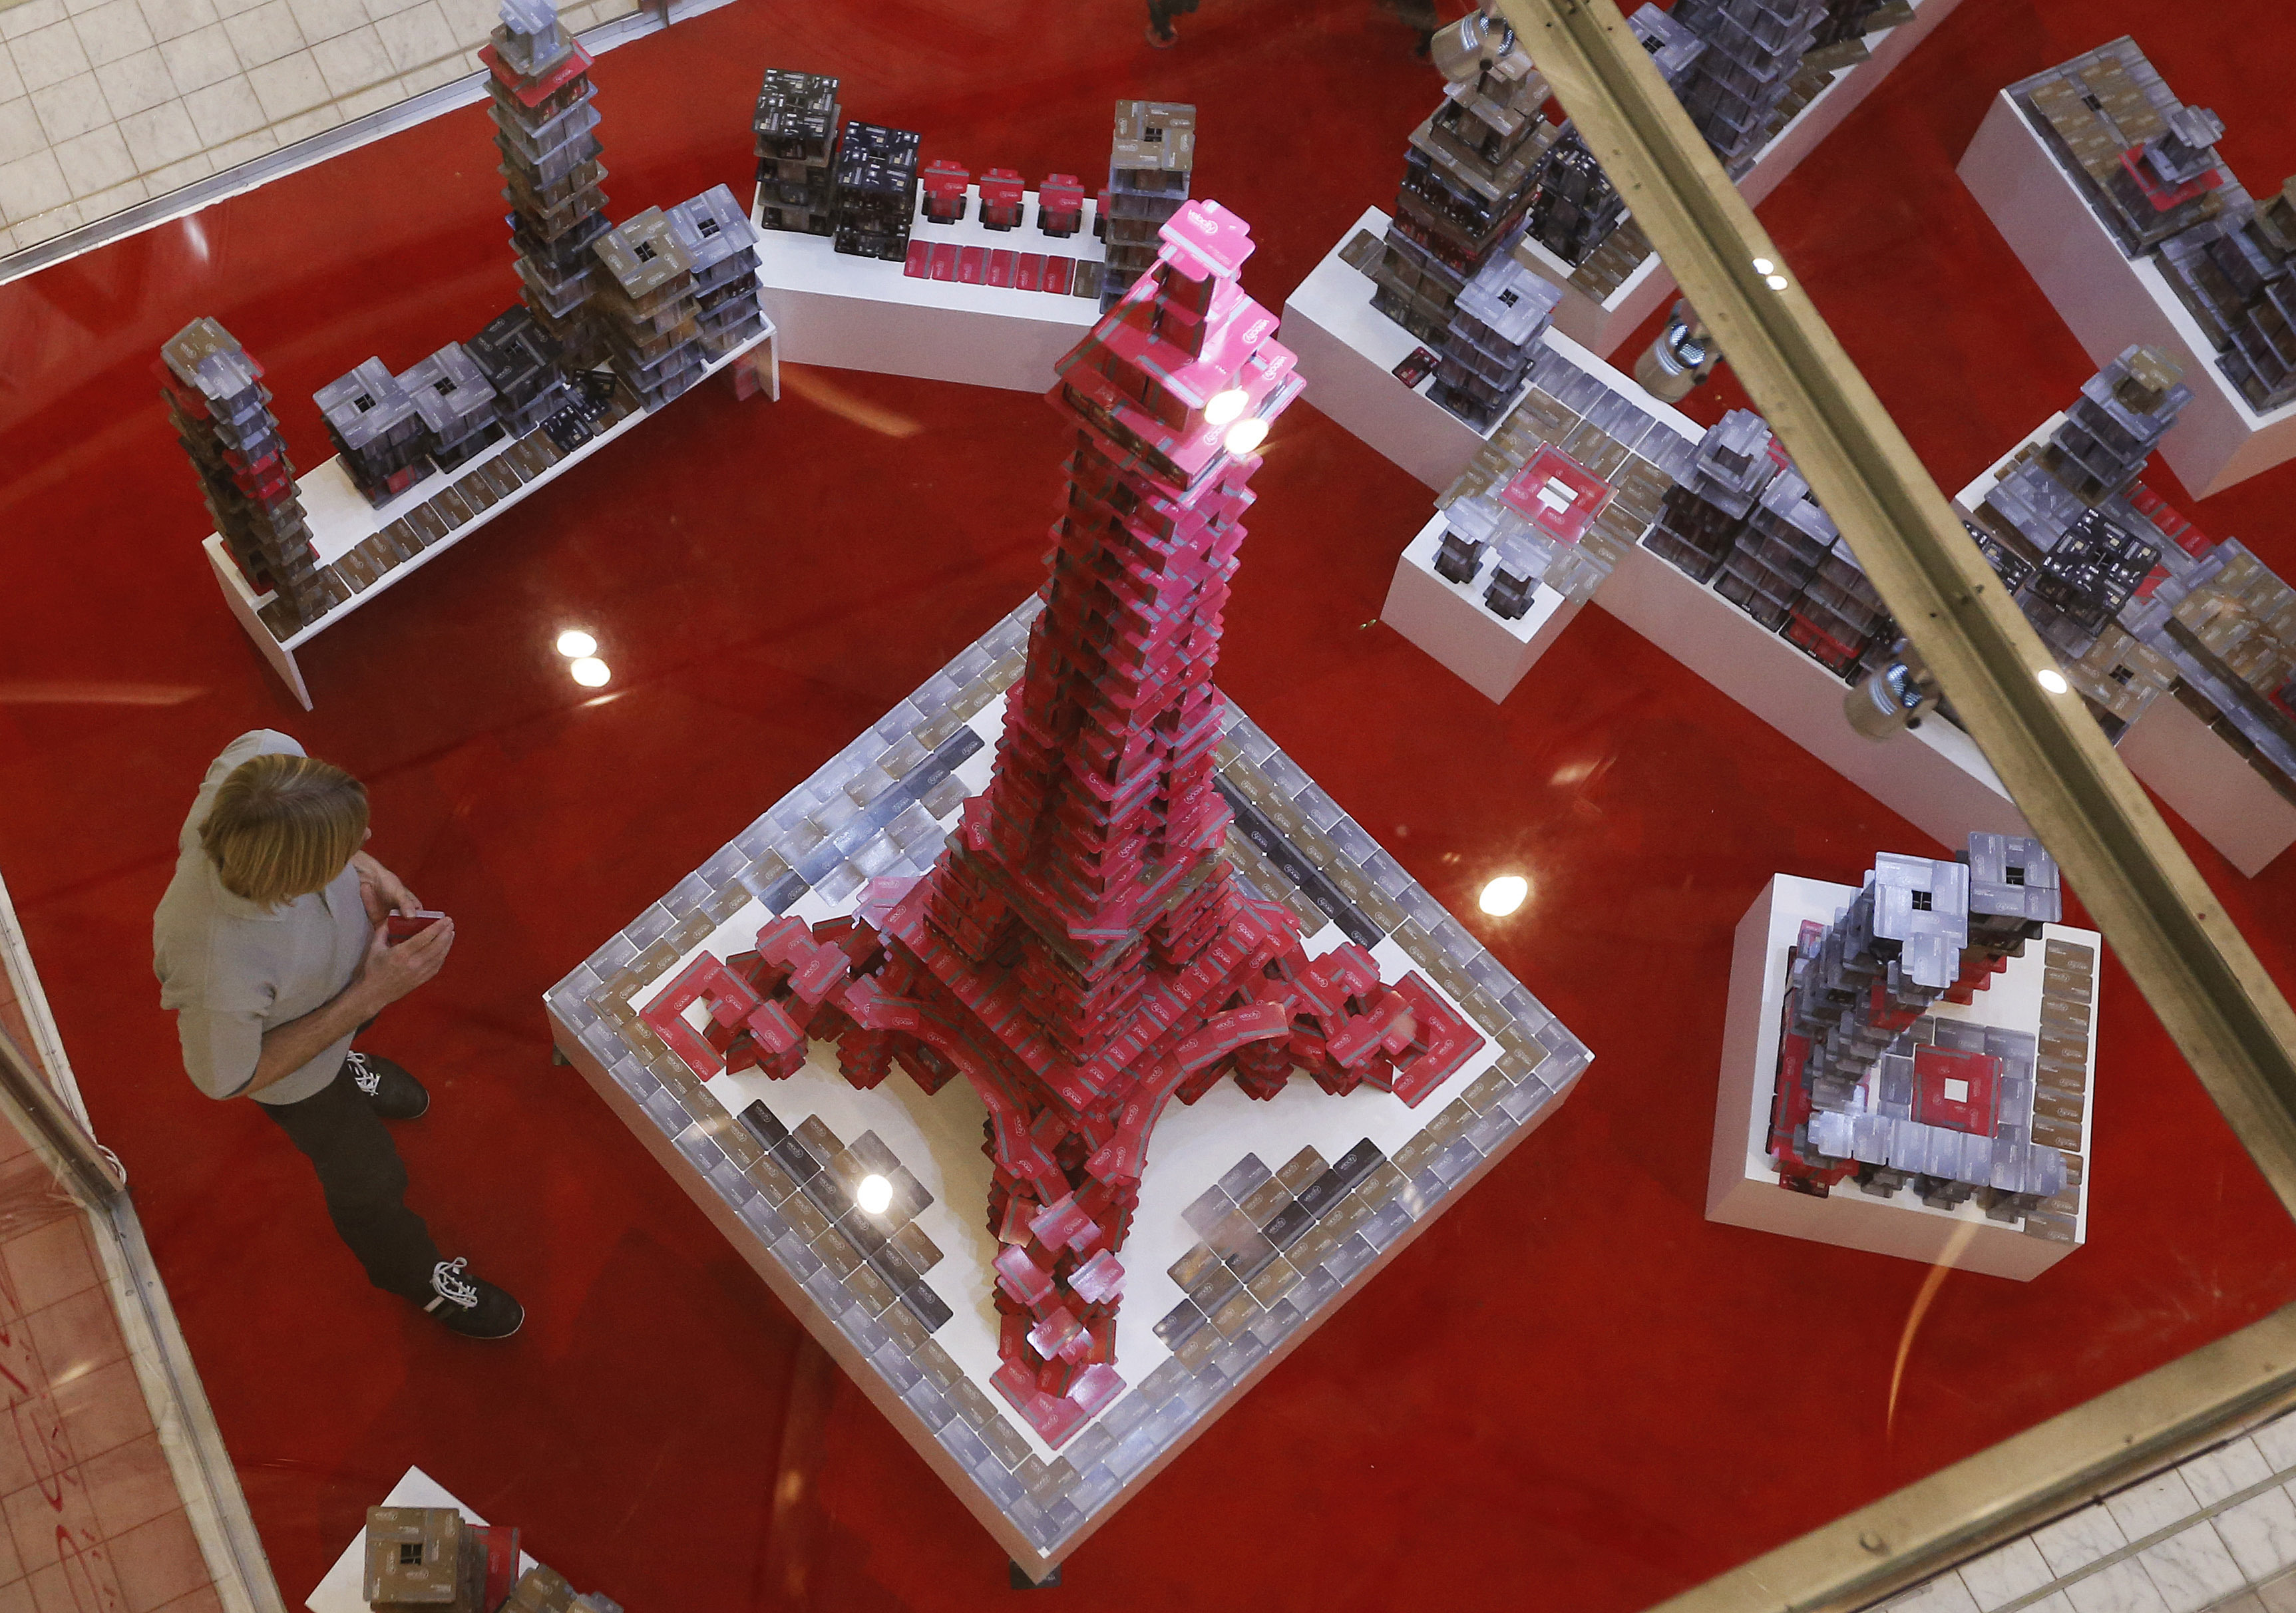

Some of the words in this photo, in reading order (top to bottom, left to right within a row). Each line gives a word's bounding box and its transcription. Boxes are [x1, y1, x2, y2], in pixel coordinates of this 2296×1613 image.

[1187, 209, 1218, 234] velocity
[1243, 319, 1270, 343] velocity
[1262, 356, 1288, 381] velocity
[803, 960, 820, 978] velocity
[1311, 970, 1328, 987] velocity
[673, 994, 691, 1011] velocity
[725, 994, 742, 1011] velocity
[1239, 1010, 1260, 1021] velocity
[1332, 1034, 1352, 1049] velocity
[1063, 1087, 1081, 1105] velocity
[756, 1105, 772, 1123] velocity
[787, 1141, 803, 1159] velocity
[1338, 1154, 1357, 1170] velocity
[1304, 1184, 1322, 1202] velocity
[1268, 1218, 1286, 1234] velocity
